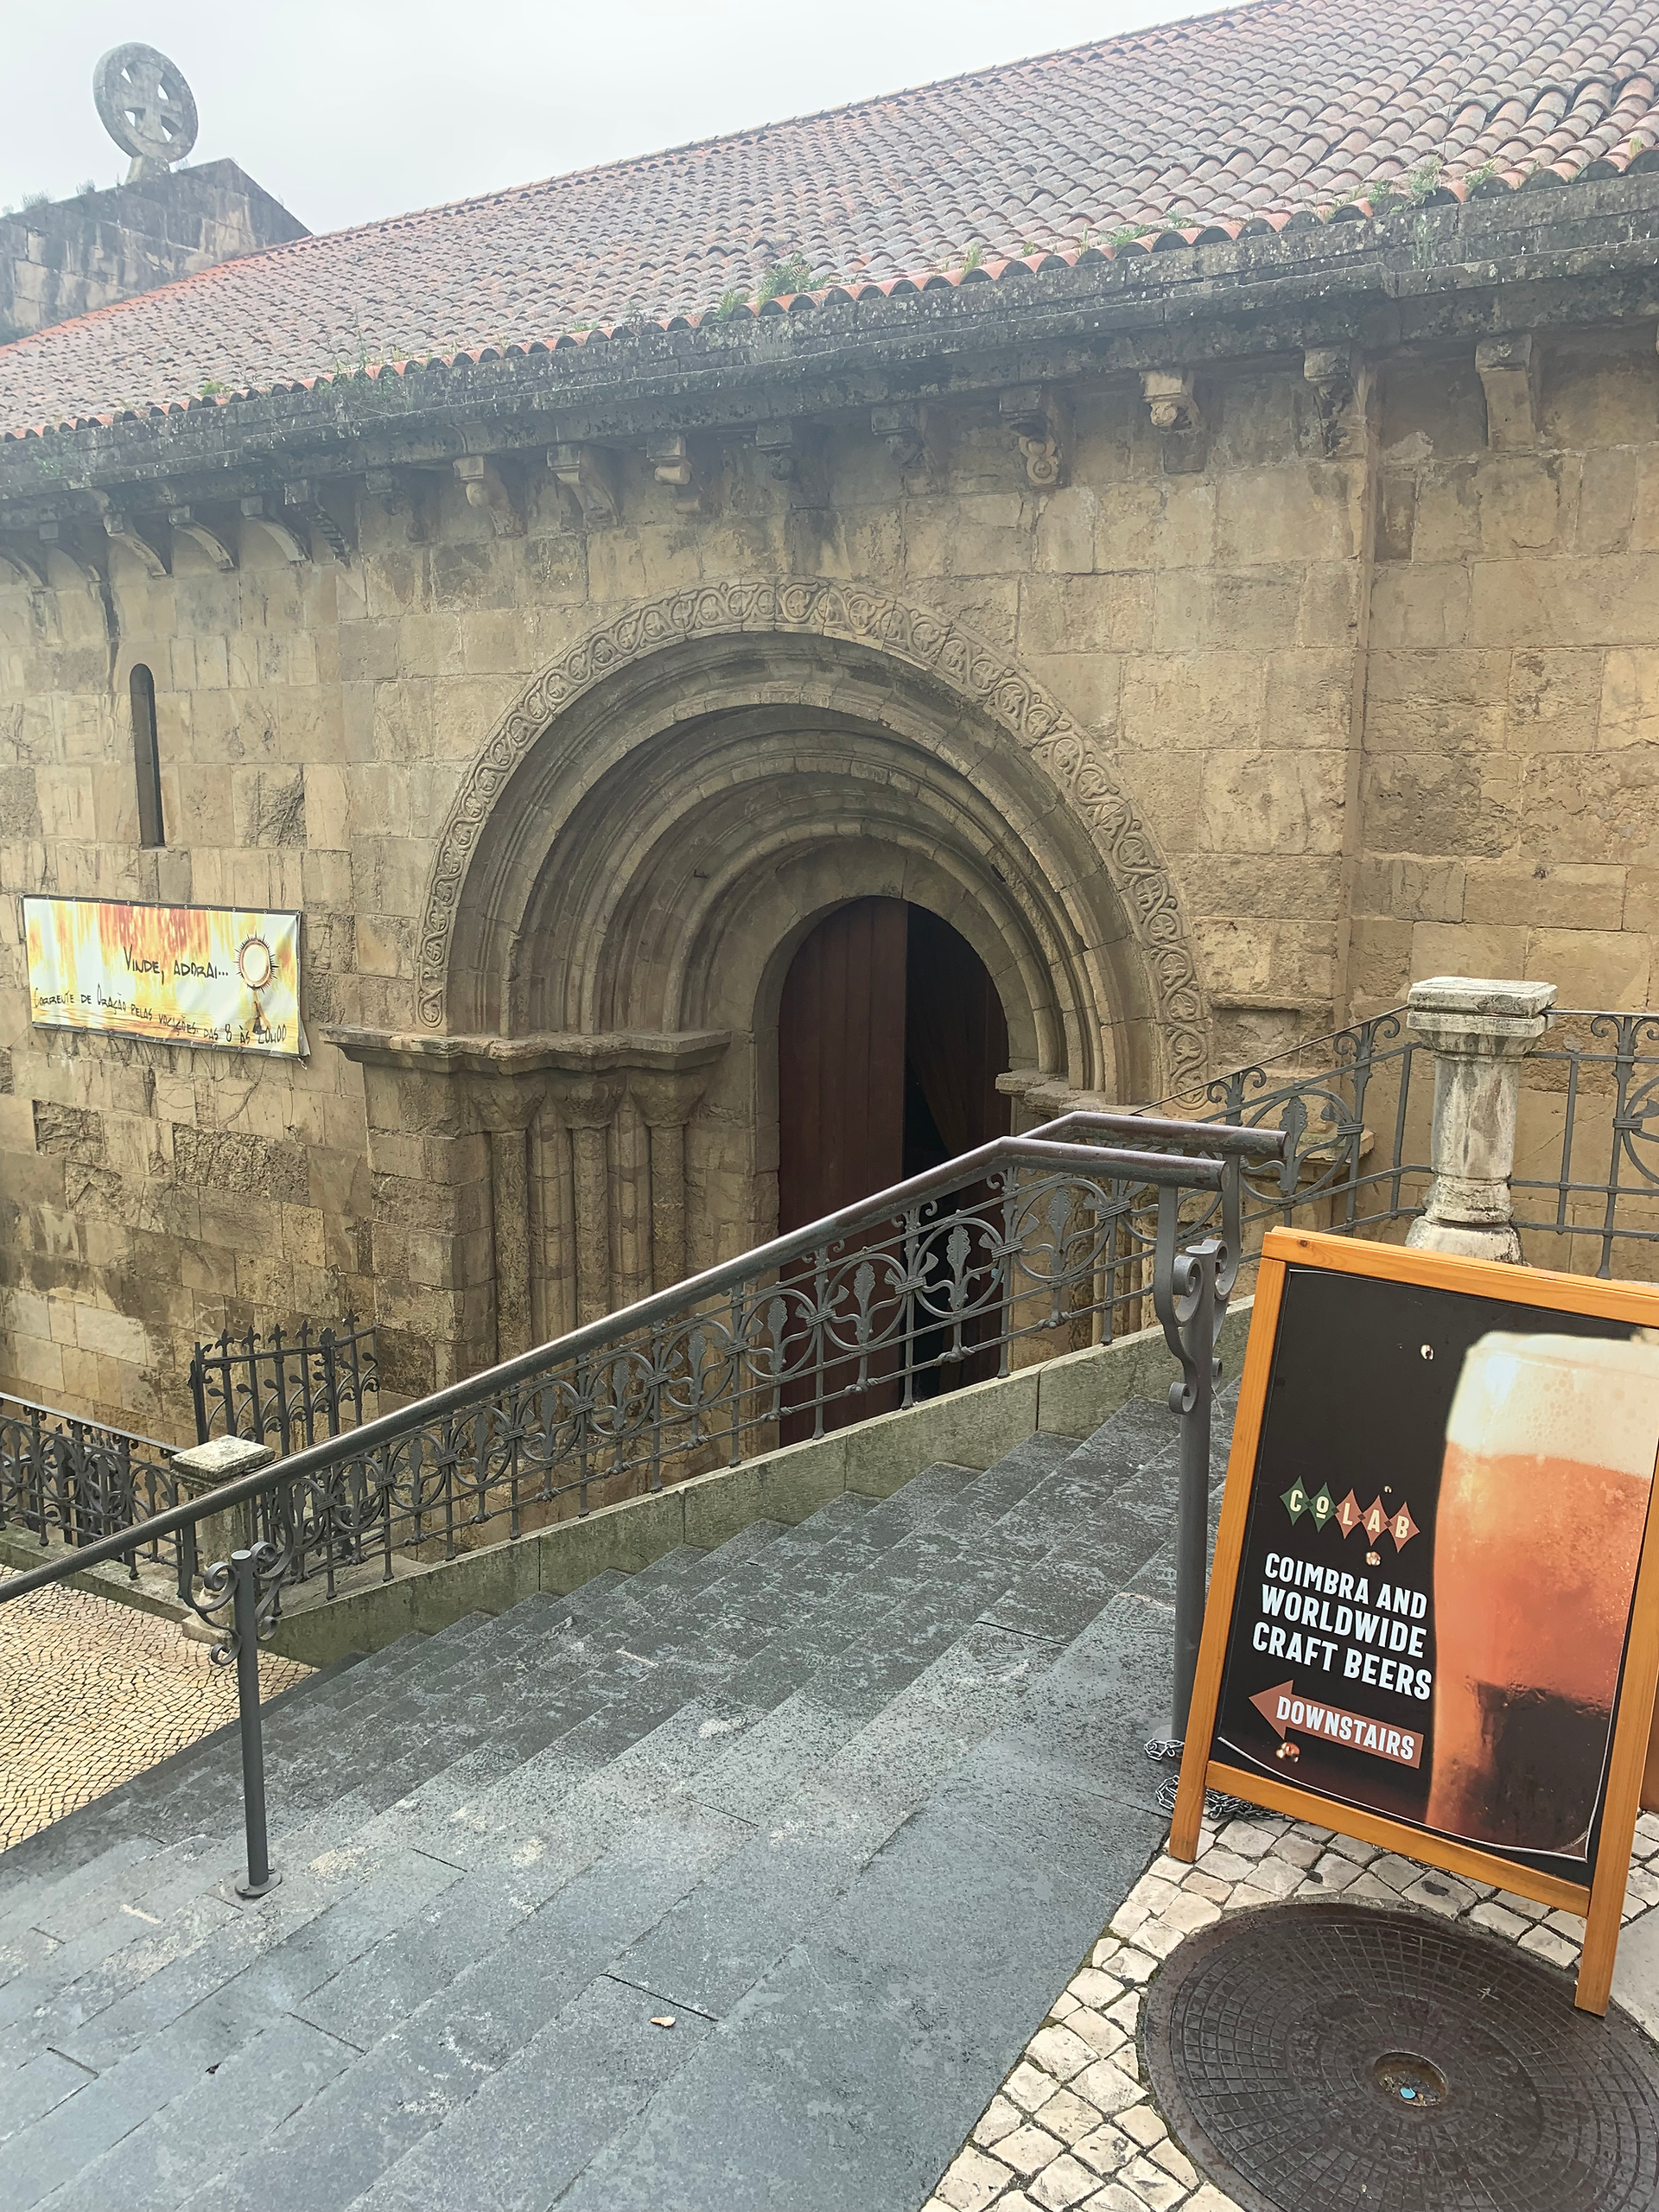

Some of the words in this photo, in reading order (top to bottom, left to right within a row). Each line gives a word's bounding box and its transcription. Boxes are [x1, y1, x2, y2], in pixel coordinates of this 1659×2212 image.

[80, 994, 92, 1004] DE
[130, 1003, 153, 1020] PELAS
[203, 1027, 218, 1040] DAS
[225, 1023, 232, 1042] 8
[1289, 1489, 1410, 1540] COLAB
[1264, 1552, 1370, 1605] COIMBRA
[1376, 1582, 1428, 1620] AND
[1261, 1583, 1427, 1659] WORLDWIDE
[1251, 1621, 1338, 1673] CRAFT
[1343, 1646, 1433, 1701] BEERS
[1275, 1695, 1414, 1761] DOWNSTAIRS
